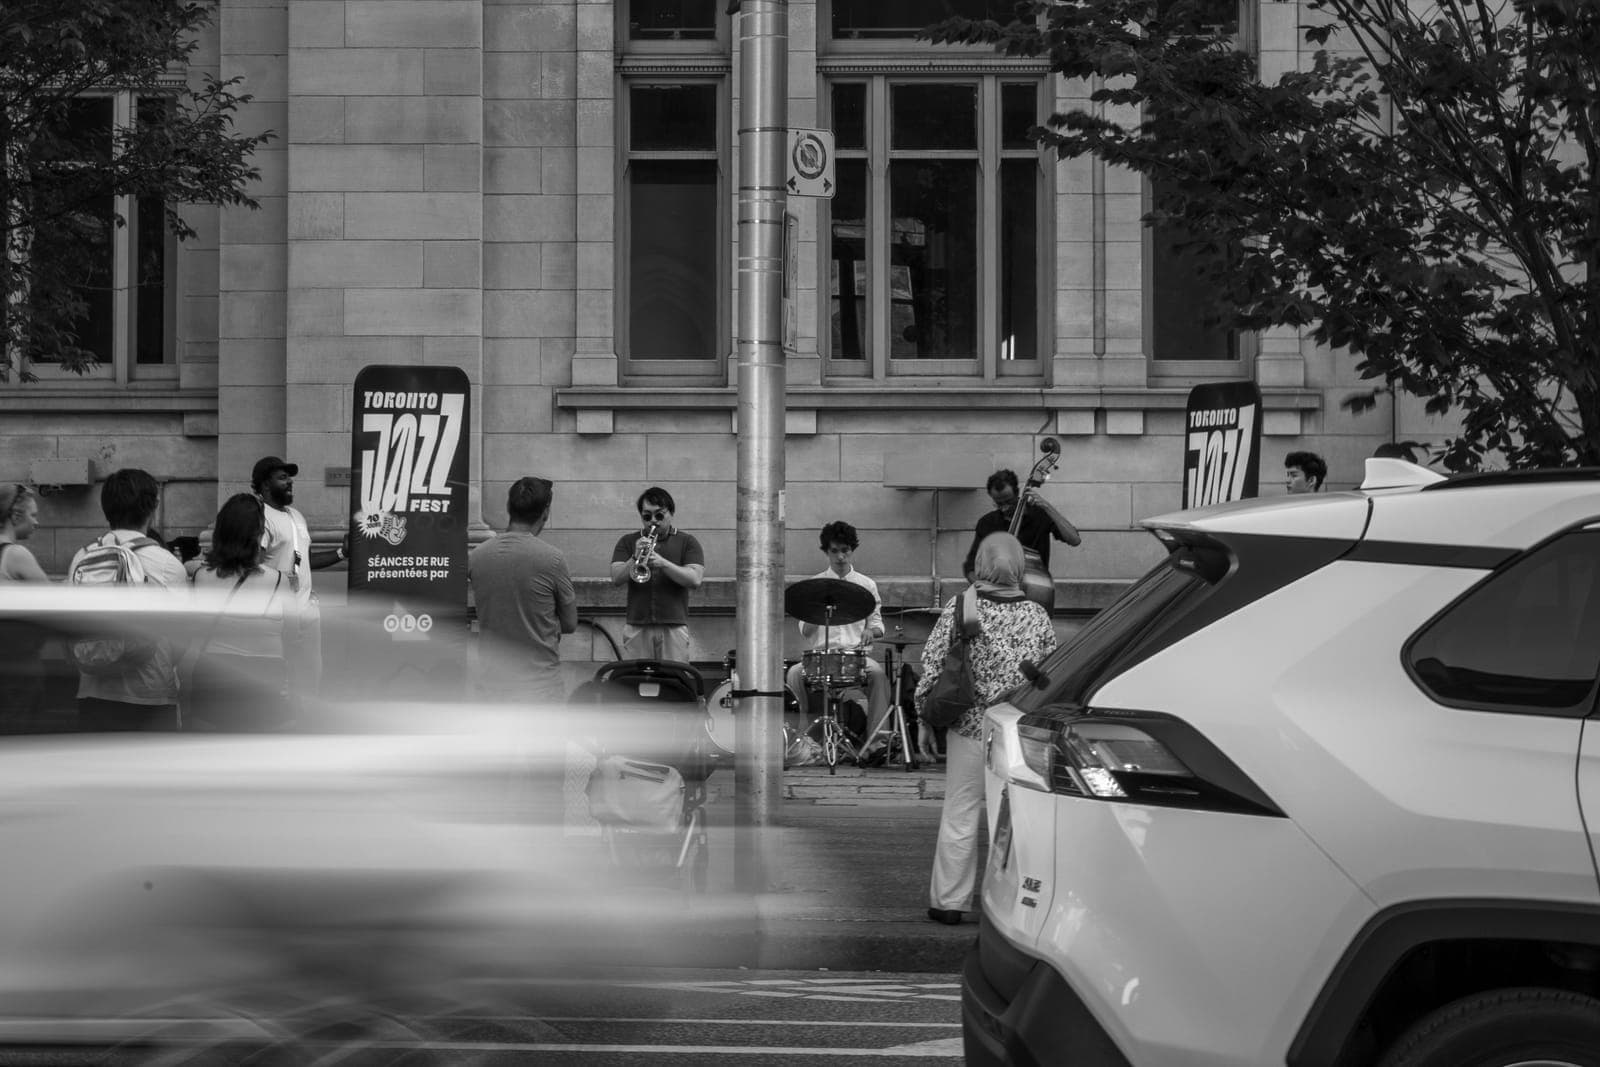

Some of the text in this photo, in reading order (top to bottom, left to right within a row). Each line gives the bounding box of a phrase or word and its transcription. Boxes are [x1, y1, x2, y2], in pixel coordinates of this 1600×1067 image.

[364, 391, 438, 409] TORONTO
[1190, 408, 1237, 428] TORONTO
[361, 393, 465, 513] JAZZ
[410, 499, 450, 513] FEST
[367, 514, 379, 522] 10
[368, 554, 450, 567] SÉANCES DE RUE
[368, 568, 449, 581] présentées par
[385, 615, 432, 631] OLG
